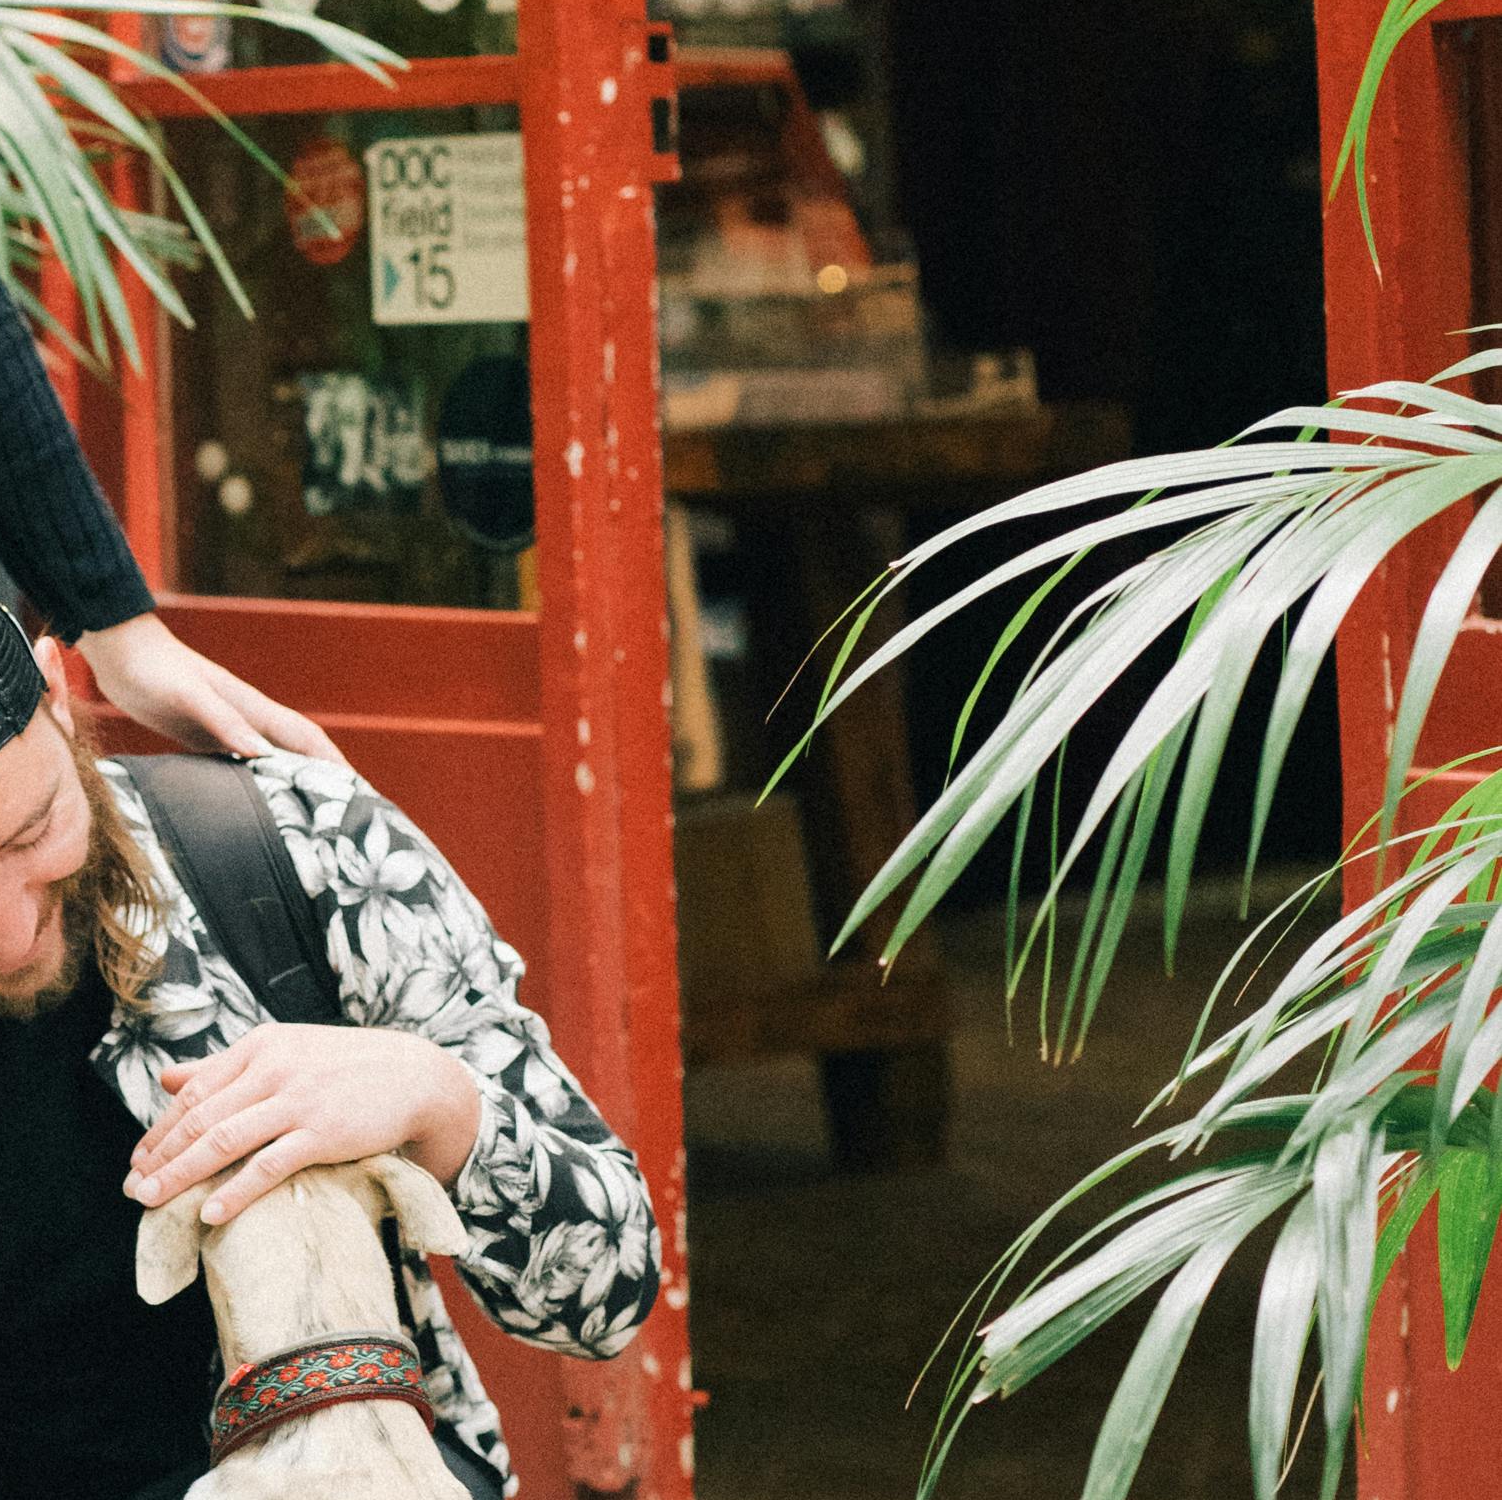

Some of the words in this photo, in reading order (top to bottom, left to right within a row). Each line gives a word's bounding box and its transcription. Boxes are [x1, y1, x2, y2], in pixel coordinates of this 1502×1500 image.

[379, 144, 452, 191] DOC
[381, 195, 455, 238] field
[404, 243, 458, 311] 15
